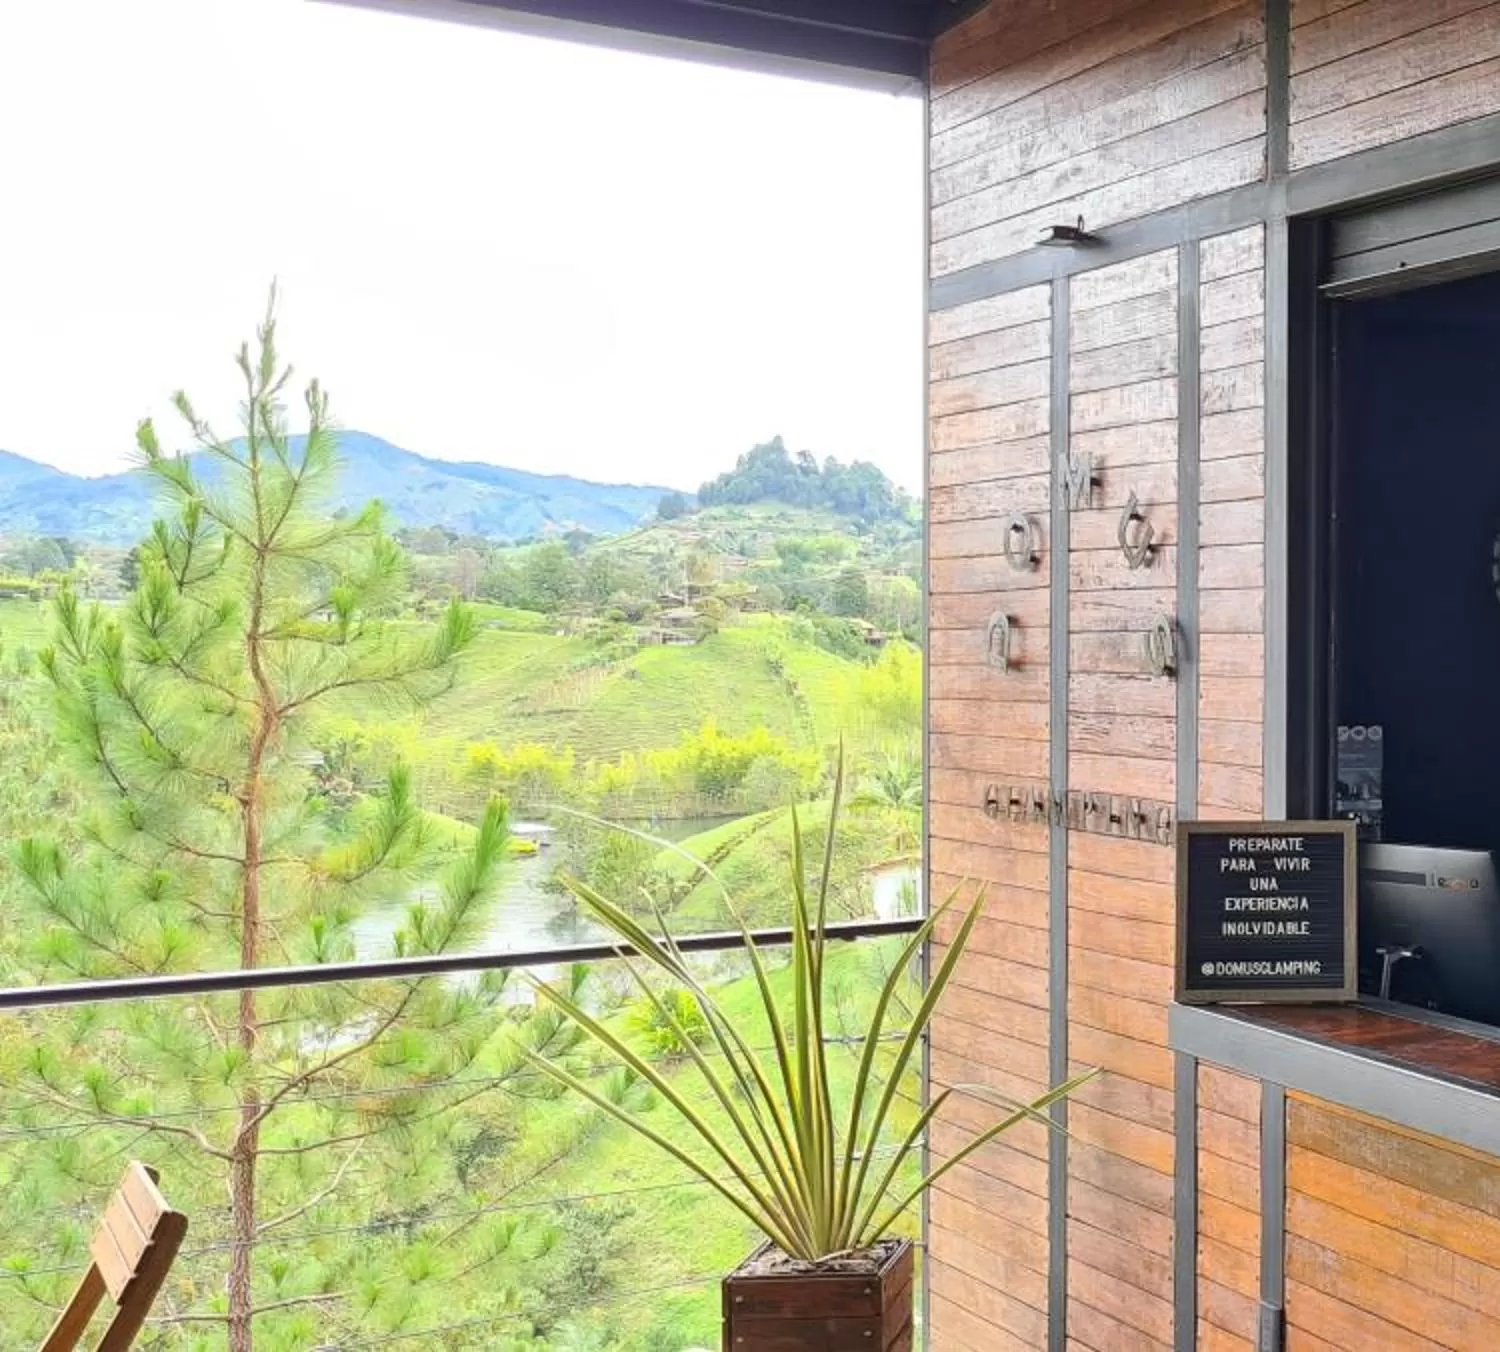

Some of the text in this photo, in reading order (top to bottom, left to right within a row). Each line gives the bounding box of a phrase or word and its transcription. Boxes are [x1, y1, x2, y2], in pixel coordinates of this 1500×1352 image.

[1229, 837, 1304, 851] PREPARATE
[1220, 857, 1311, 872] PARA VIVIR
[1250, 877, 1278, 891] UNA
[1224, 896, 1309, 911] EXPERIENCIA
[1222, 921, 1310, 936] INOLVIDABLE
[1201, 960, 1321, 976] @DOMUSGLAMPING
